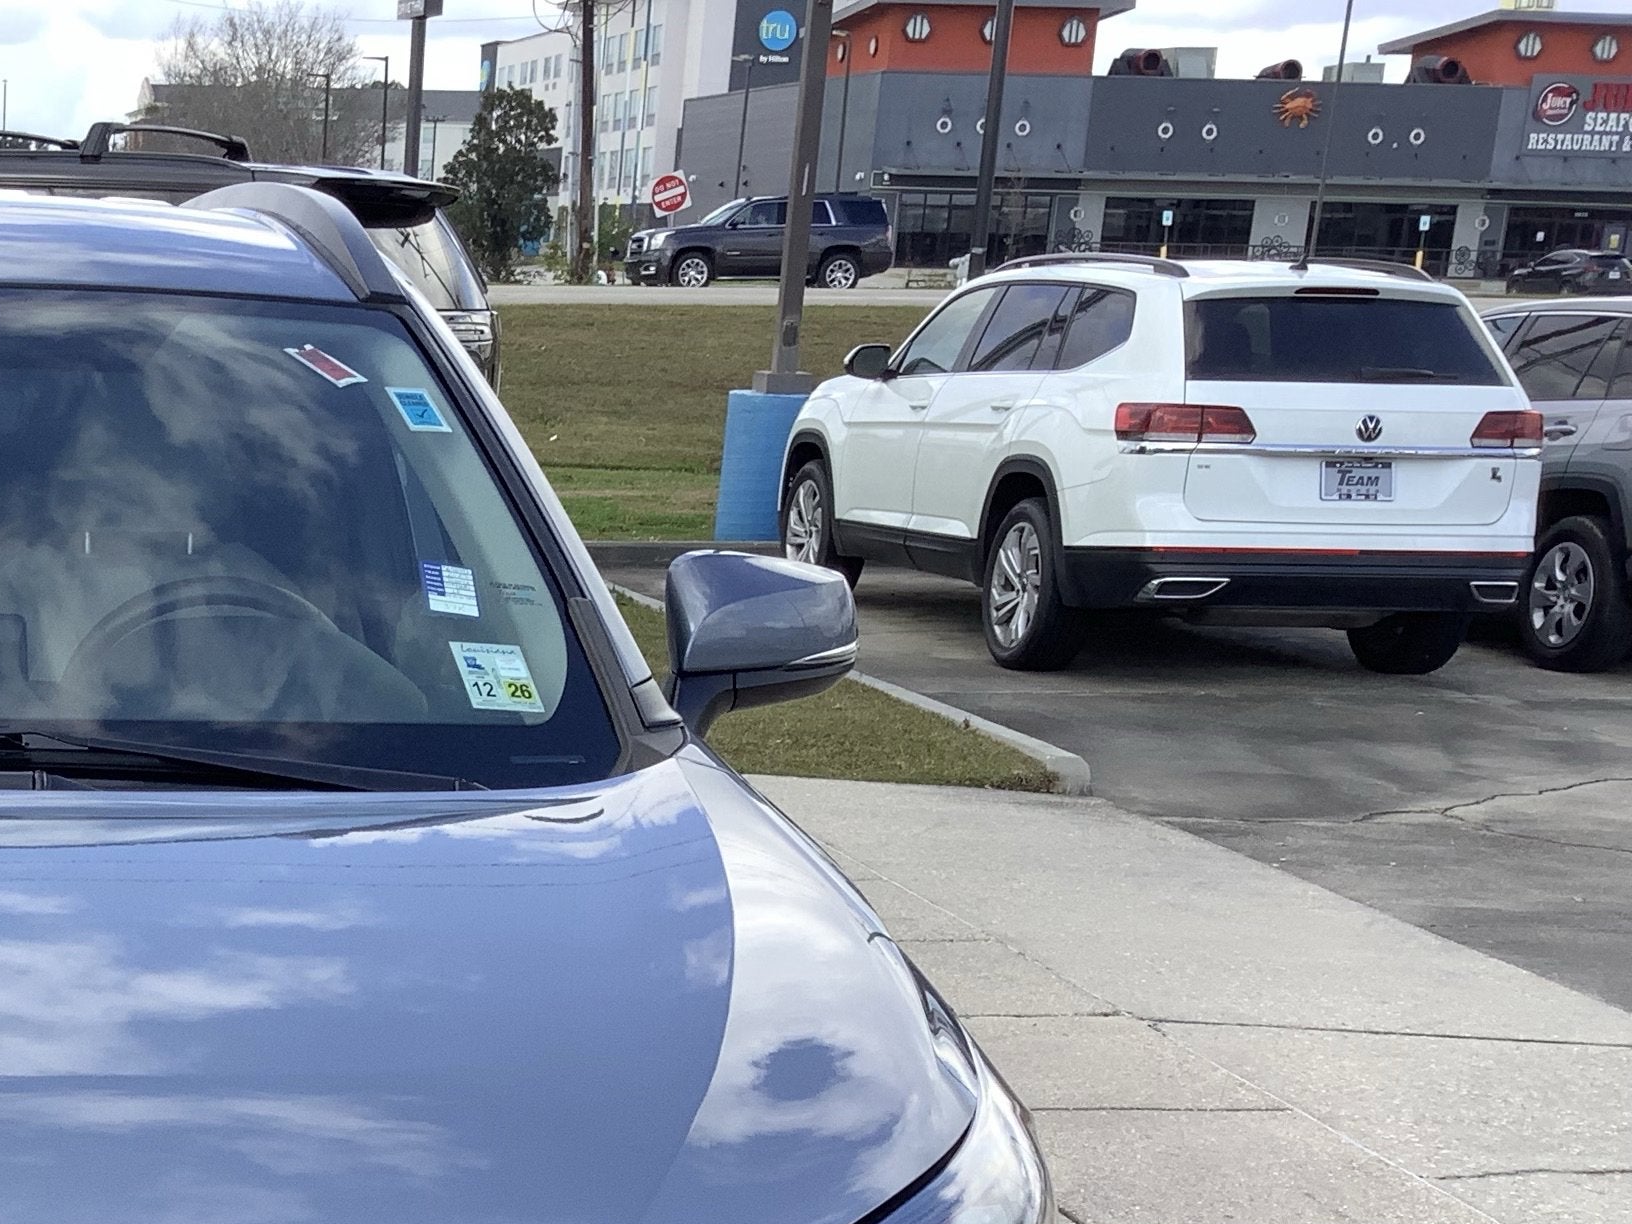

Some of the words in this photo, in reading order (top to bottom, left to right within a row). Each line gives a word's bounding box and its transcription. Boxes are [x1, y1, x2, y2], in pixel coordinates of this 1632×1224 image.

[760, 18, 789, 39] tru
[1527, 132, 1620, 151] RESTAURANT
[654, 184, 665, 194] DO
[665, 179, 680, 189] NOT
[660, 195, 682, 209] ENTER
[1337, 469, 1380, 487] TEAM
[460, 643, 517, 655] Louisiana
[472, 681, 497, 698] 12
[508, 682, 533, 699] 26
